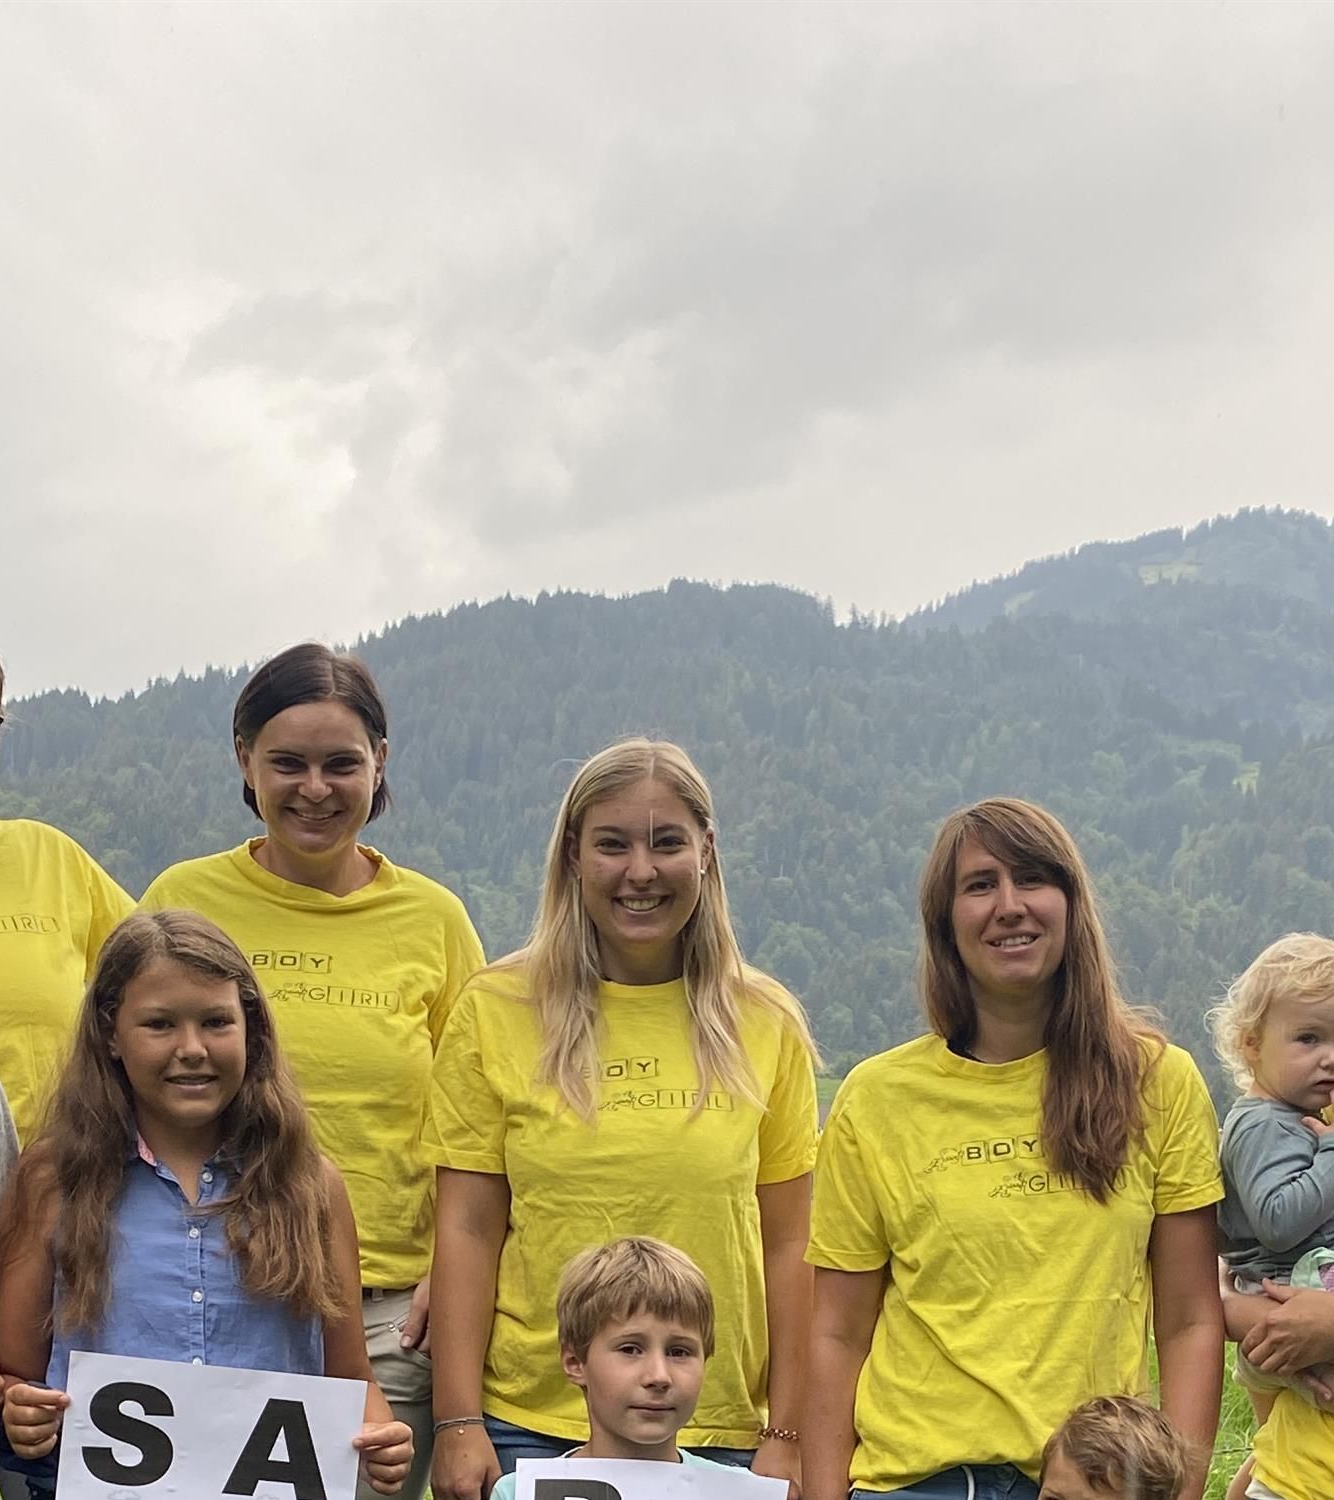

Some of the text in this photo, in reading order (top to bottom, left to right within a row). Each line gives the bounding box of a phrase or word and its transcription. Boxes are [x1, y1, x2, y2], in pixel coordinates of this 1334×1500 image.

[252, 954, 324, 969] BOY
[308, 987, 391, 1007] GIRL
[966, 1139, 1037, 1160] BOY
